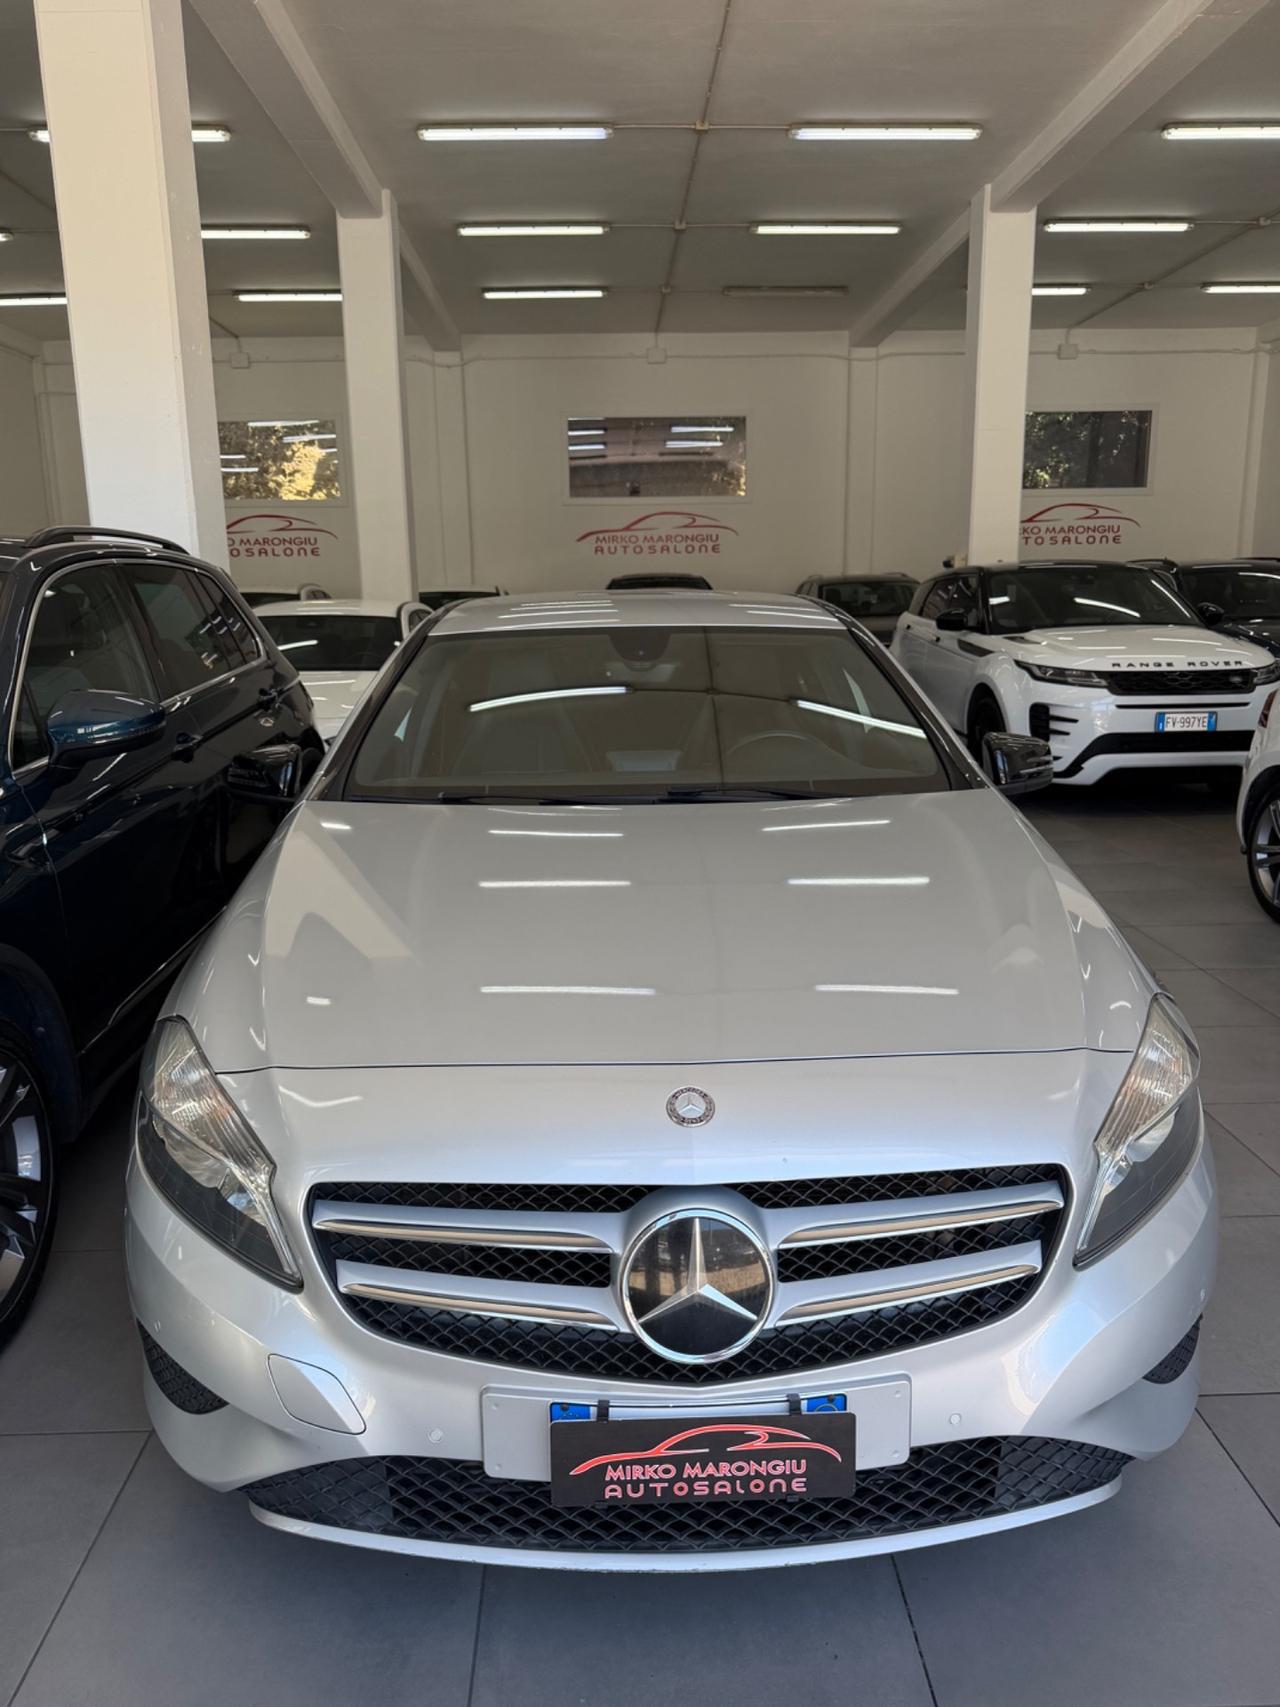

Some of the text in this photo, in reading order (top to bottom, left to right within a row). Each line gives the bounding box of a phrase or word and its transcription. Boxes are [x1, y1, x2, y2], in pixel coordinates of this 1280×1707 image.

[1045, 525, 1121, 535] MARONGIU
[239, 537, 318, 547] MARONGIU
[595, 534, 720, 545] MIRKO MARONGIU
[1022, 534, 1122, 546] TOSALONE
[229, 546, 321, 557] OSALONE
[594, 544, 721, 555] AUTOSALONE
[604, 1459, 807, 1481] MIRKO MARONGIU
[604, 1477, 807, 1499] AUTOSALONE
